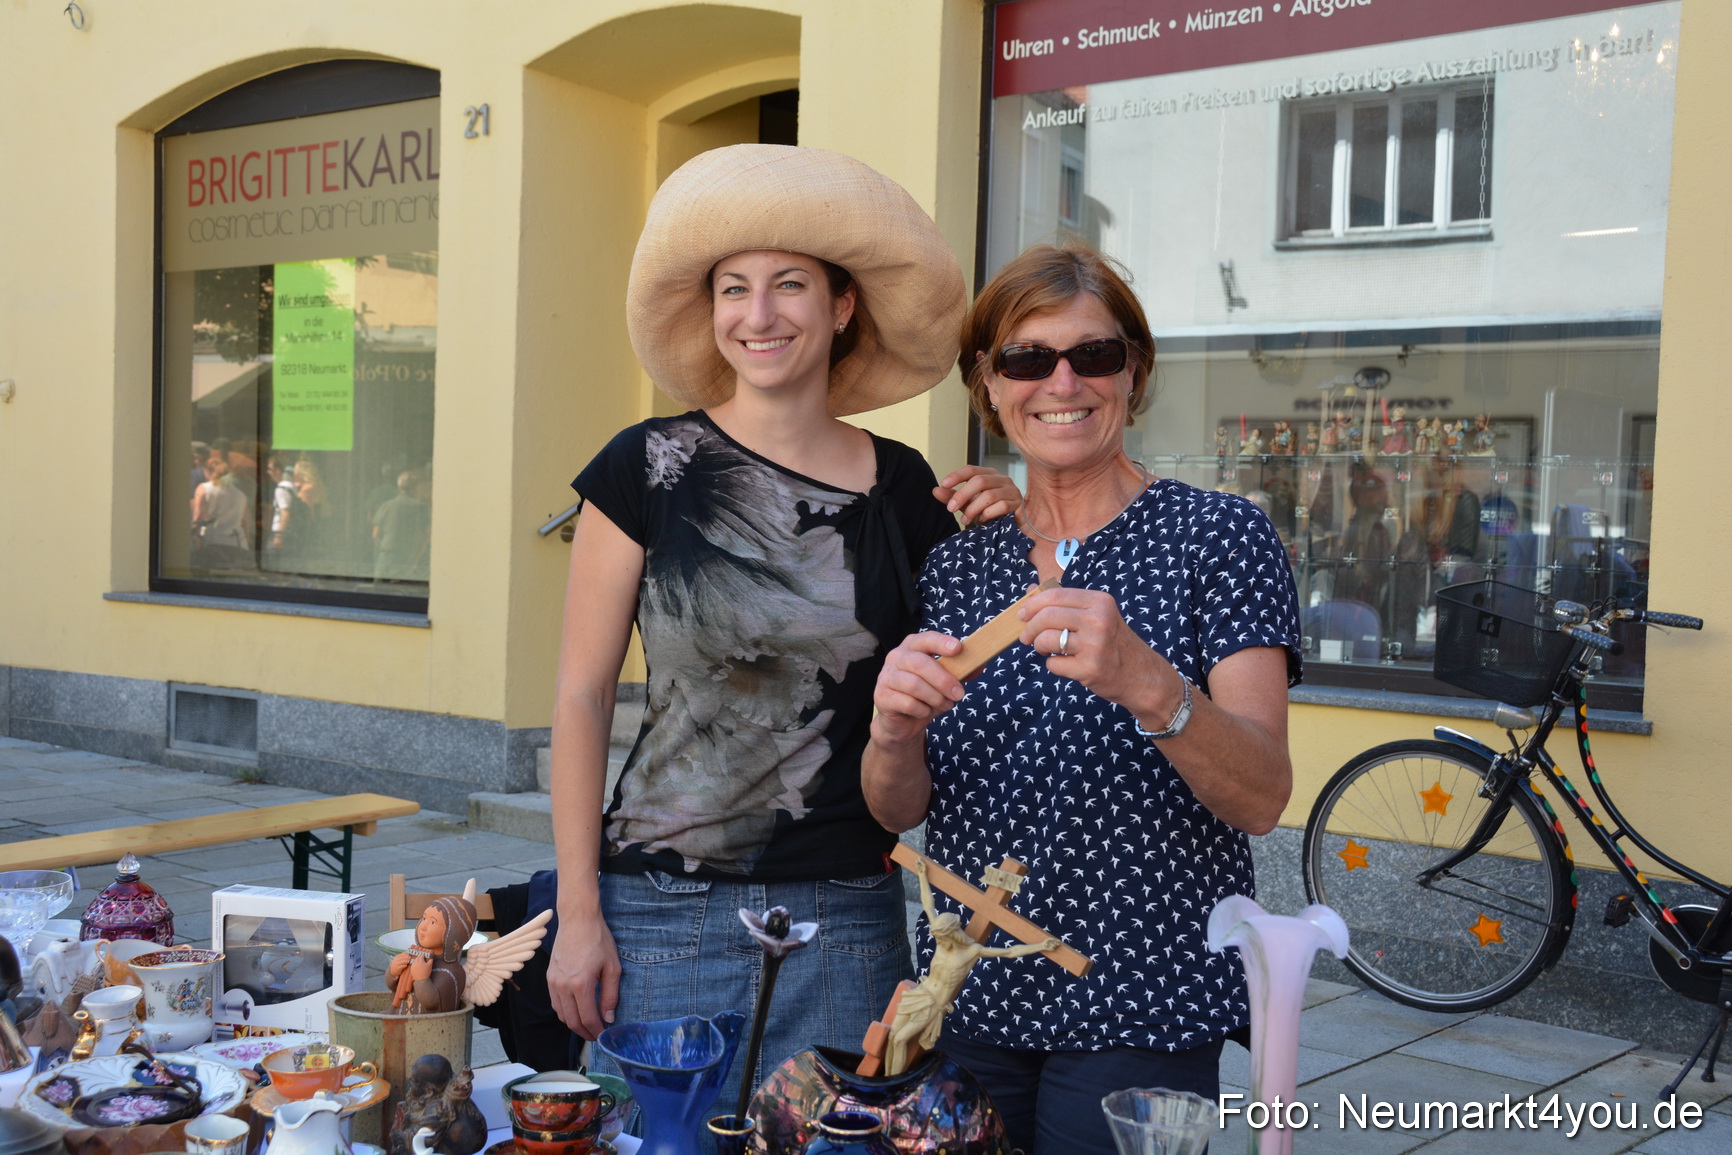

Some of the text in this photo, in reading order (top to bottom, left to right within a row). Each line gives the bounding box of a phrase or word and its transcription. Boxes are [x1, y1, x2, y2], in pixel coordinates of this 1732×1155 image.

[1002, 0, 1372, 61] Uhren Schmuck Münzen Altgo
[1022, 104, 1086, 131] Ankauf
[1259, 76, 1299, 102] und
[1305, 65, 1412, 96] sofortige
[1414, 47, 1559, 81] Auszahlung
[1600, 28, 1654, 58] bar!
[463, 103, 490, 139] 21
[188, 206, 294, 243] cosmetic
